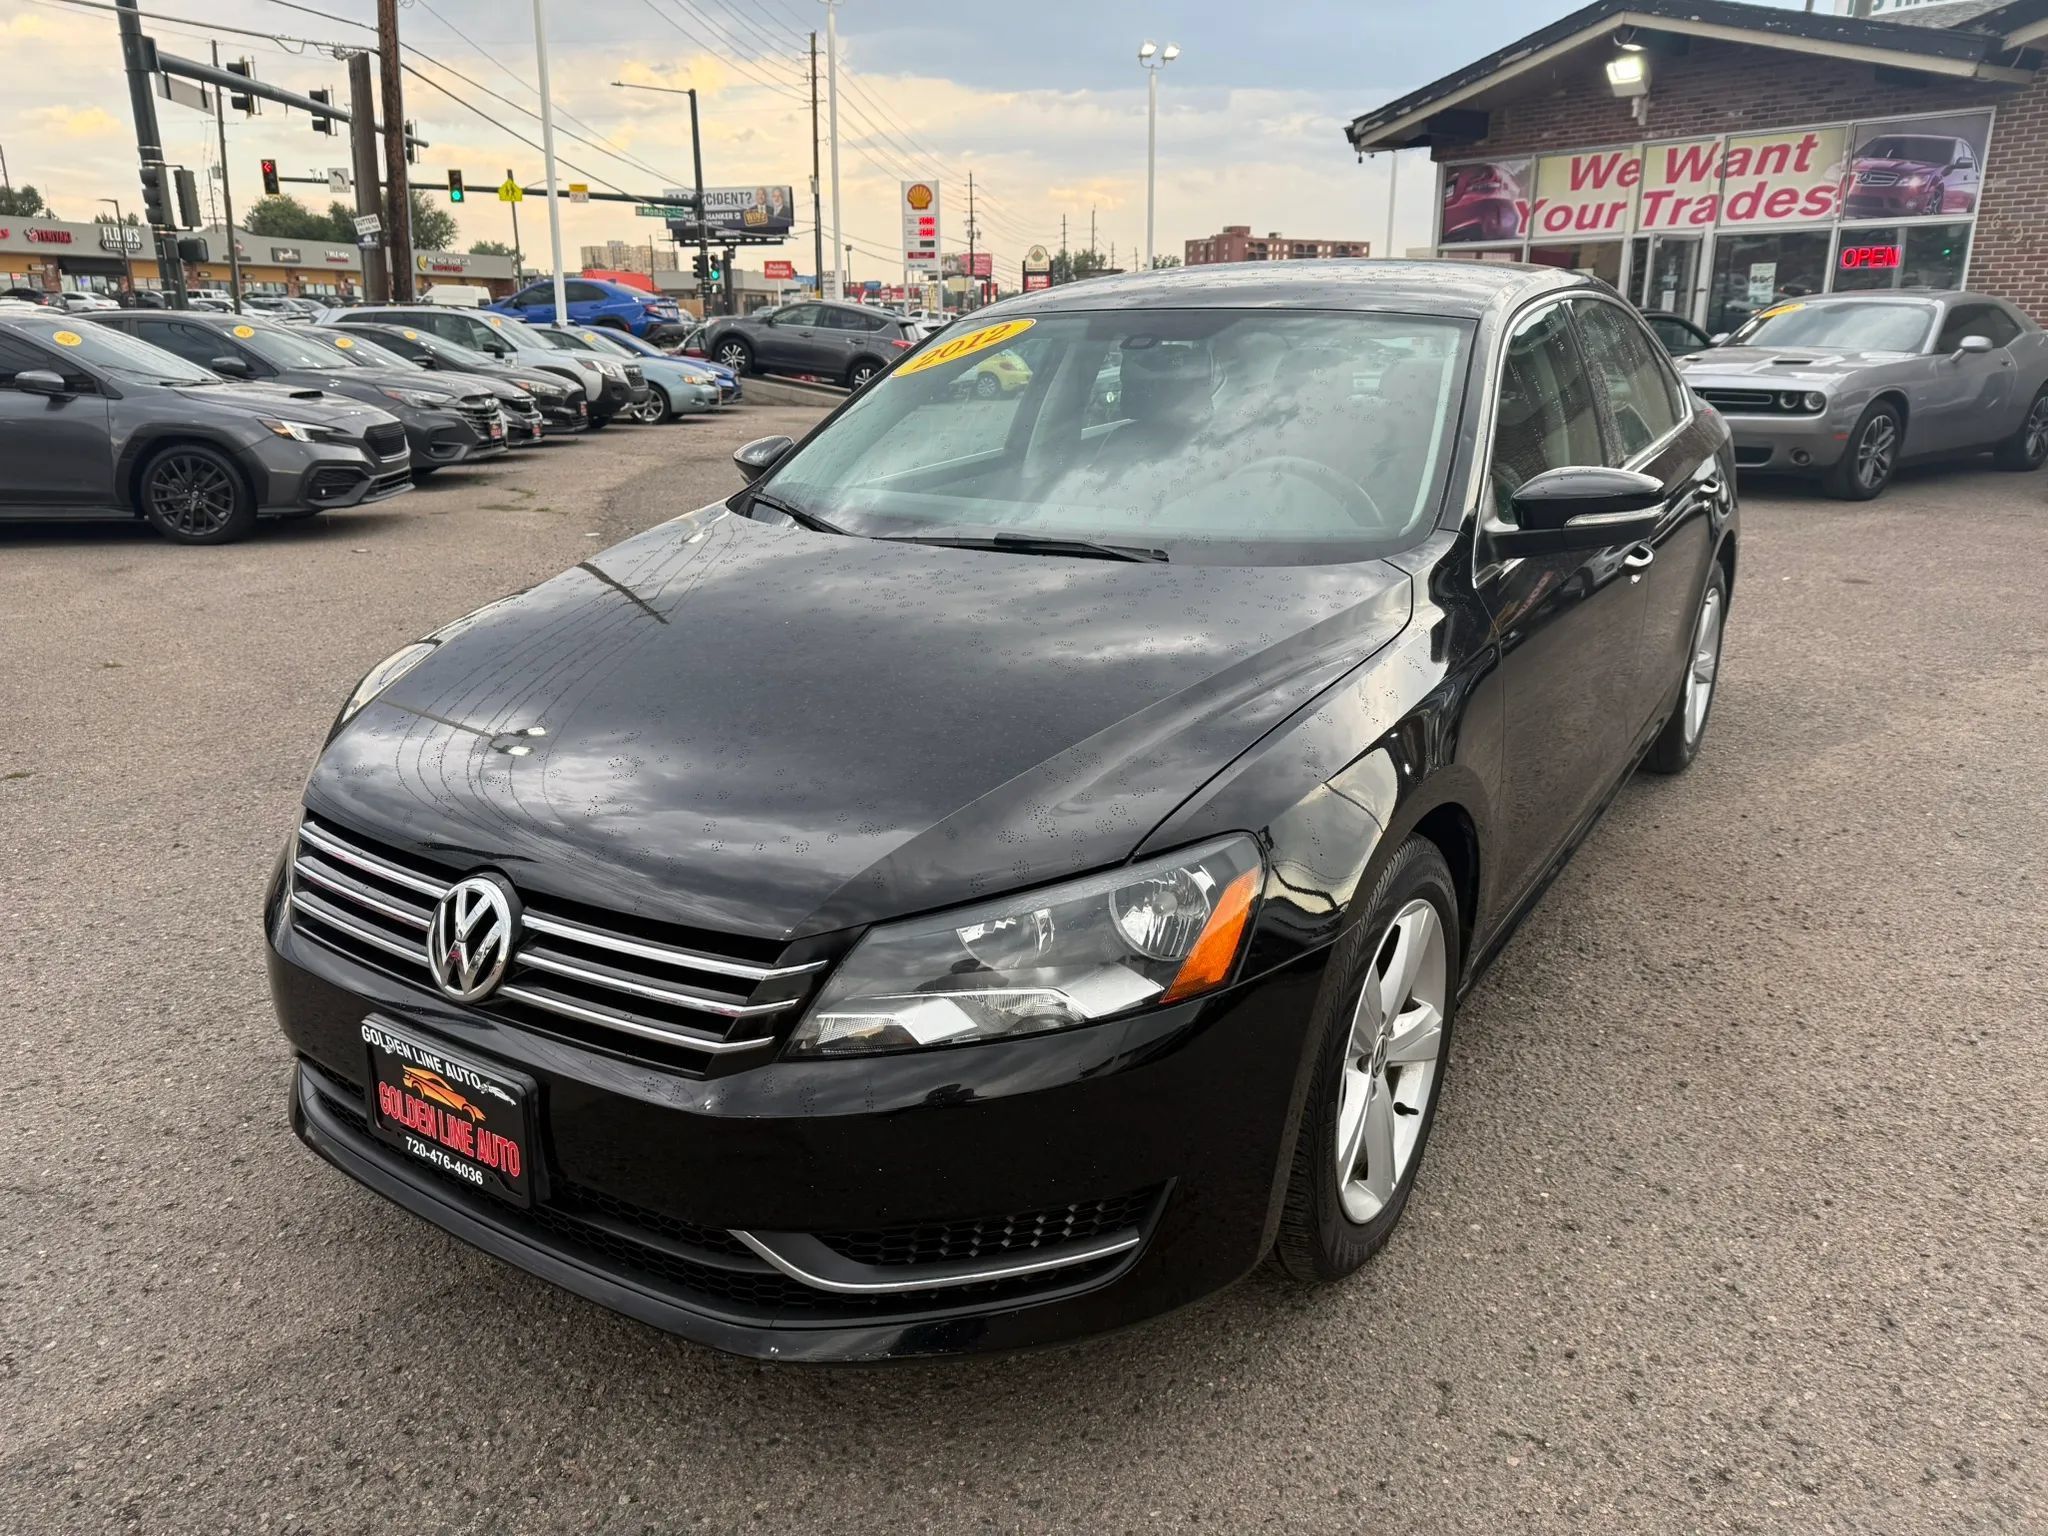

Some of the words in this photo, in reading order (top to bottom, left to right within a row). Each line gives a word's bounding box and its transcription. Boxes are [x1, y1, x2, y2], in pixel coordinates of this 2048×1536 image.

[1570, 153, 1641, 191] We
[1665, 133, 1818, 184] Want
[702, 192, 752, 206] CIDENT?
[1515, 199, 1627, 233] Your
[1643, 174, 1855, 227] Trades!
[1841, 246, 1902, 269] OPEN
[912, 323, 1012, 370] 2012
[361, 1025, 411, 1060] GOLDEN
[413, 1048, 443, 1073] LINE
[445, 1062, 481, 1090] AUTO
[379, 1081, 437, 1139] GOLDEN
[438, 1109, 474, 1157] LINE
[477, 1127, 520, 1177] AUTO
[405, 1136, 483, 1185] 720-476-4036
